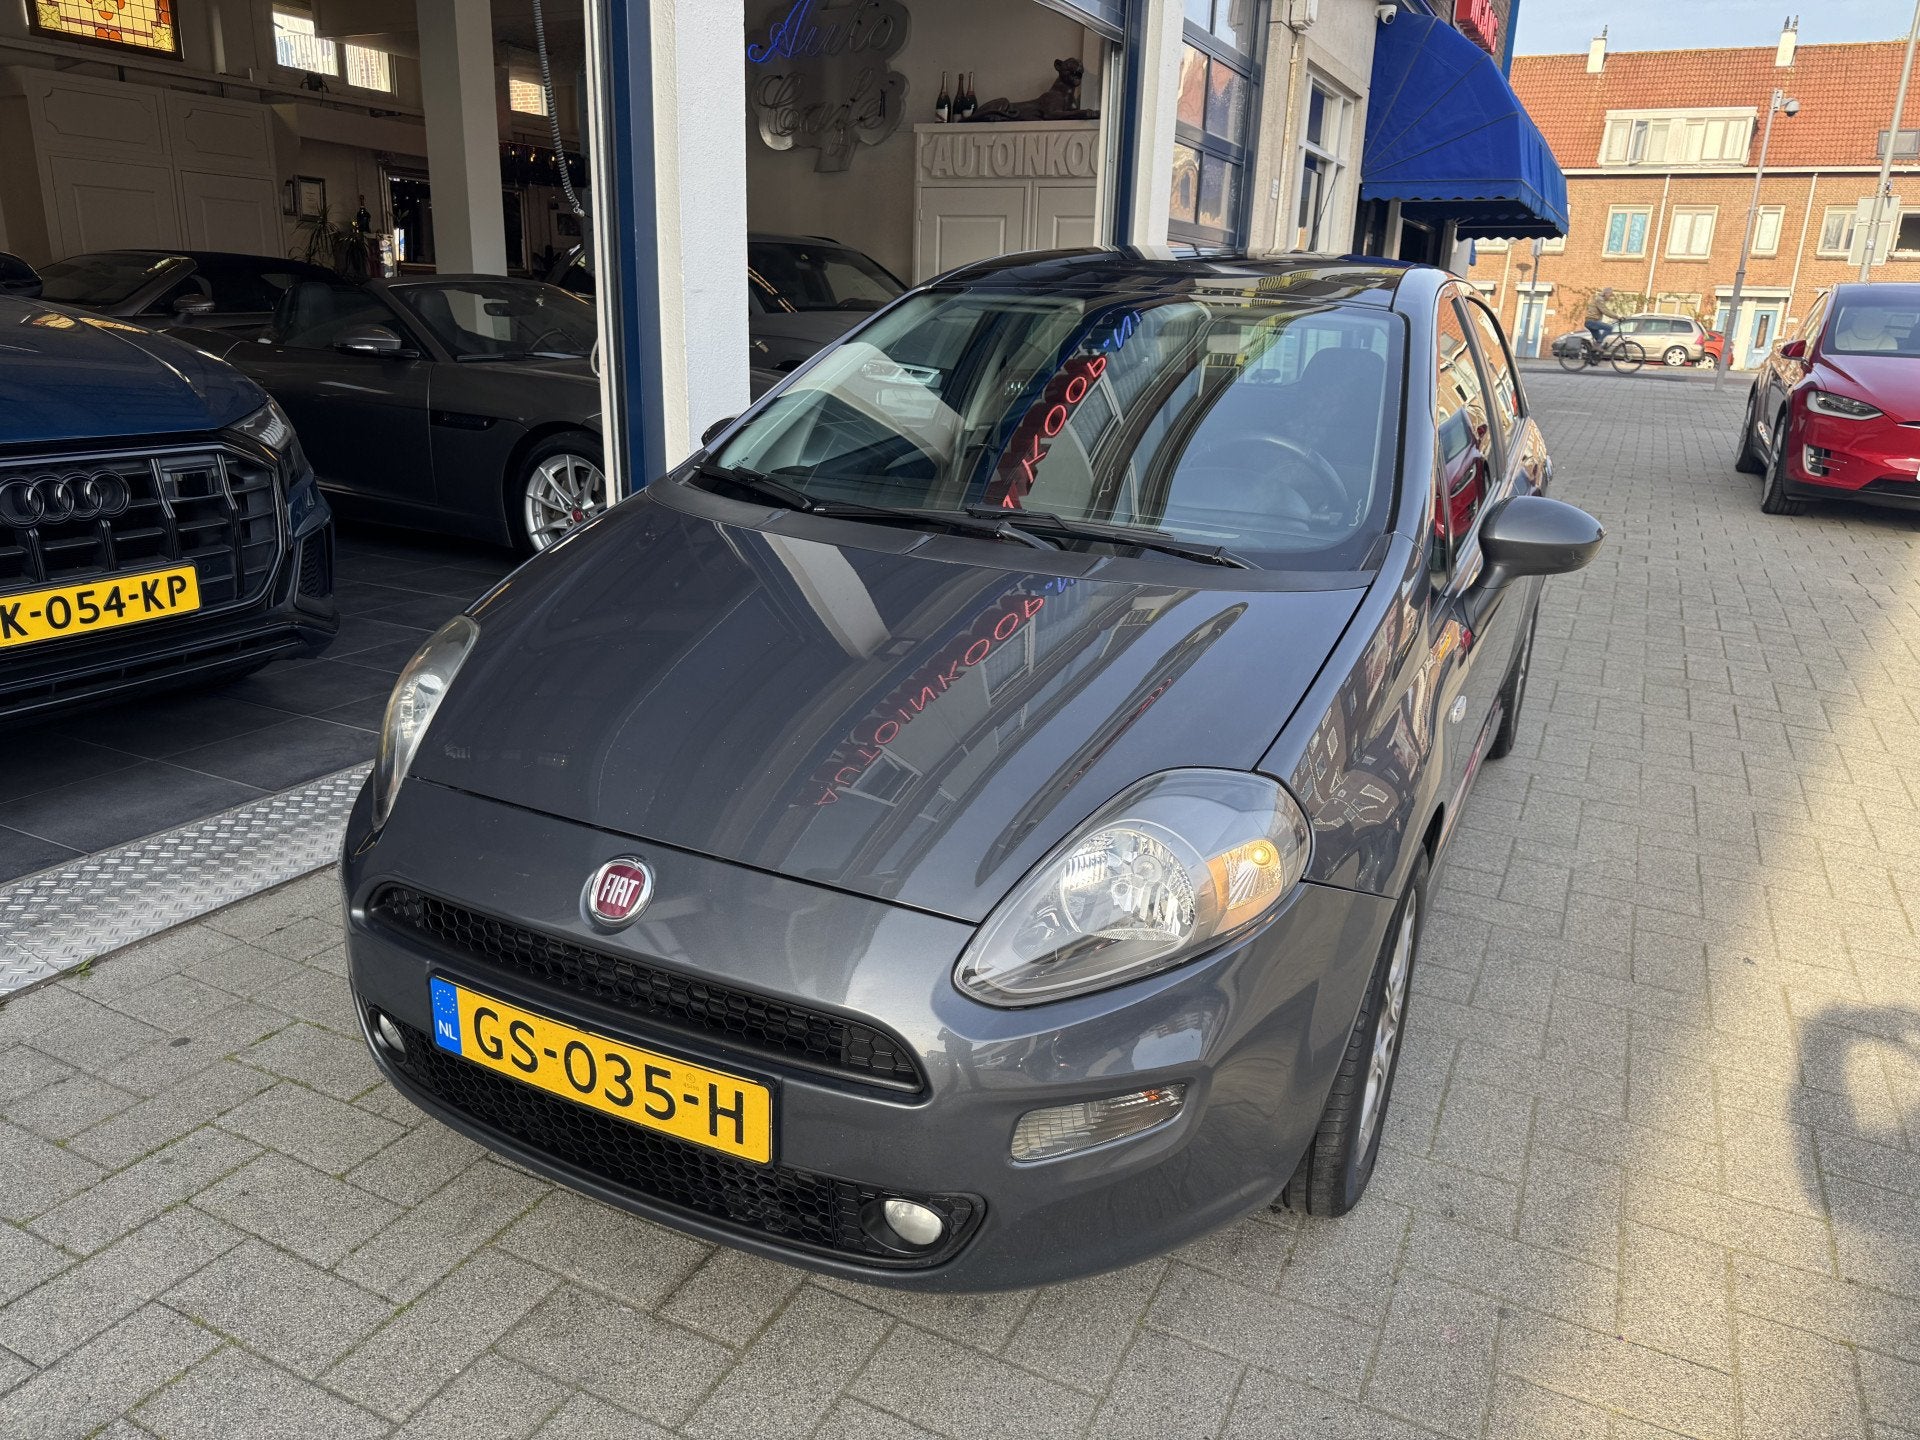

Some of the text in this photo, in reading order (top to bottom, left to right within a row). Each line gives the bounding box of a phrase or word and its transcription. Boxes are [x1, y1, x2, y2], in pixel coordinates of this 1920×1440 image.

[748, 0, 894, 62] Auto
[0, 575, 187, 639] K-054-KP
[600, 873, 640, 908] FIAT
[439, 1019, 458, 1041] NL
[474, 1007, 744, 1144] GS-035-H
